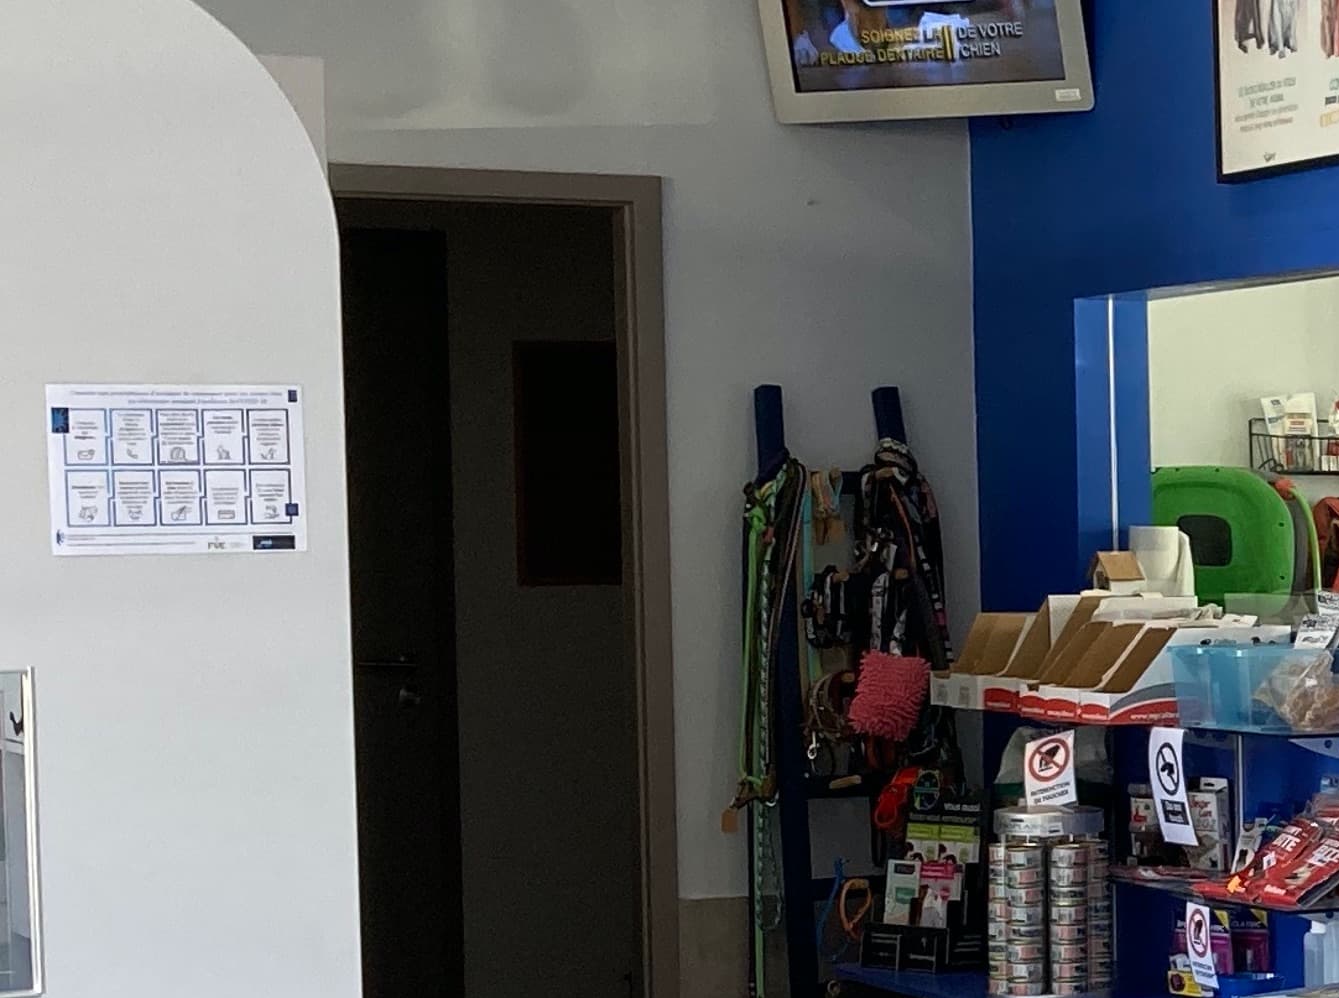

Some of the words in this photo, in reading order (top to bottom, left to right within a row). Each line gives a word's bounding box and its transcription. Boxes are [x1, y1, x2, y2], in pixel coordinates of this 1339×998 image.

[957, 25, 977, 39] DE
[979, 21, 1024, 38] VOTRE
[820, 50, 875, 65] PLAQUE
[876, 47, 944, 62] DENTAIRE
[960, 42, 1001, 57] CHIEN
